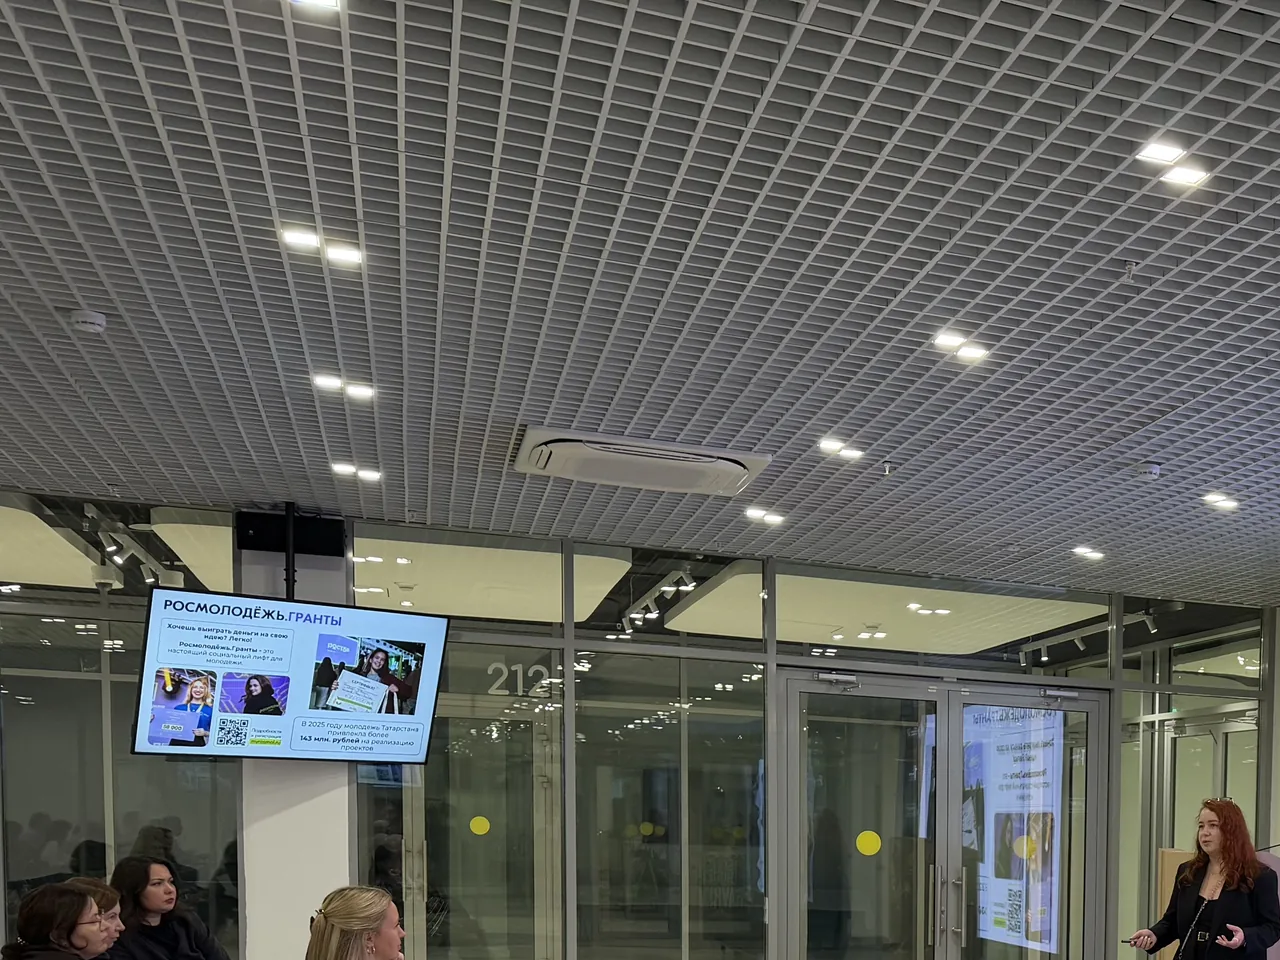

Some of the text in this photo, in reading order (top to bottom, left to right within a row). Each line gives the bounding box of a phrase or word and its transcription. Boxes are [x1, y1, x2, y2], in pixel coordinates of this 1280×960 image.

[163, 599, 342, 627] РОСМОЛОДЁЖЬ.ГРАНТЫ
[167, 623, 196, 632] Хочешь
[198, 626, 232, 636] выиграть
[233, 629, 259, 638] деньги
[204, 634, 227, 642] идею?
[487, 662, 551, 698] 212
[326, 722, 343, 731] году
[381, 725, 419, 733] Татарстана
[332, 736, 360, 745] рублей
